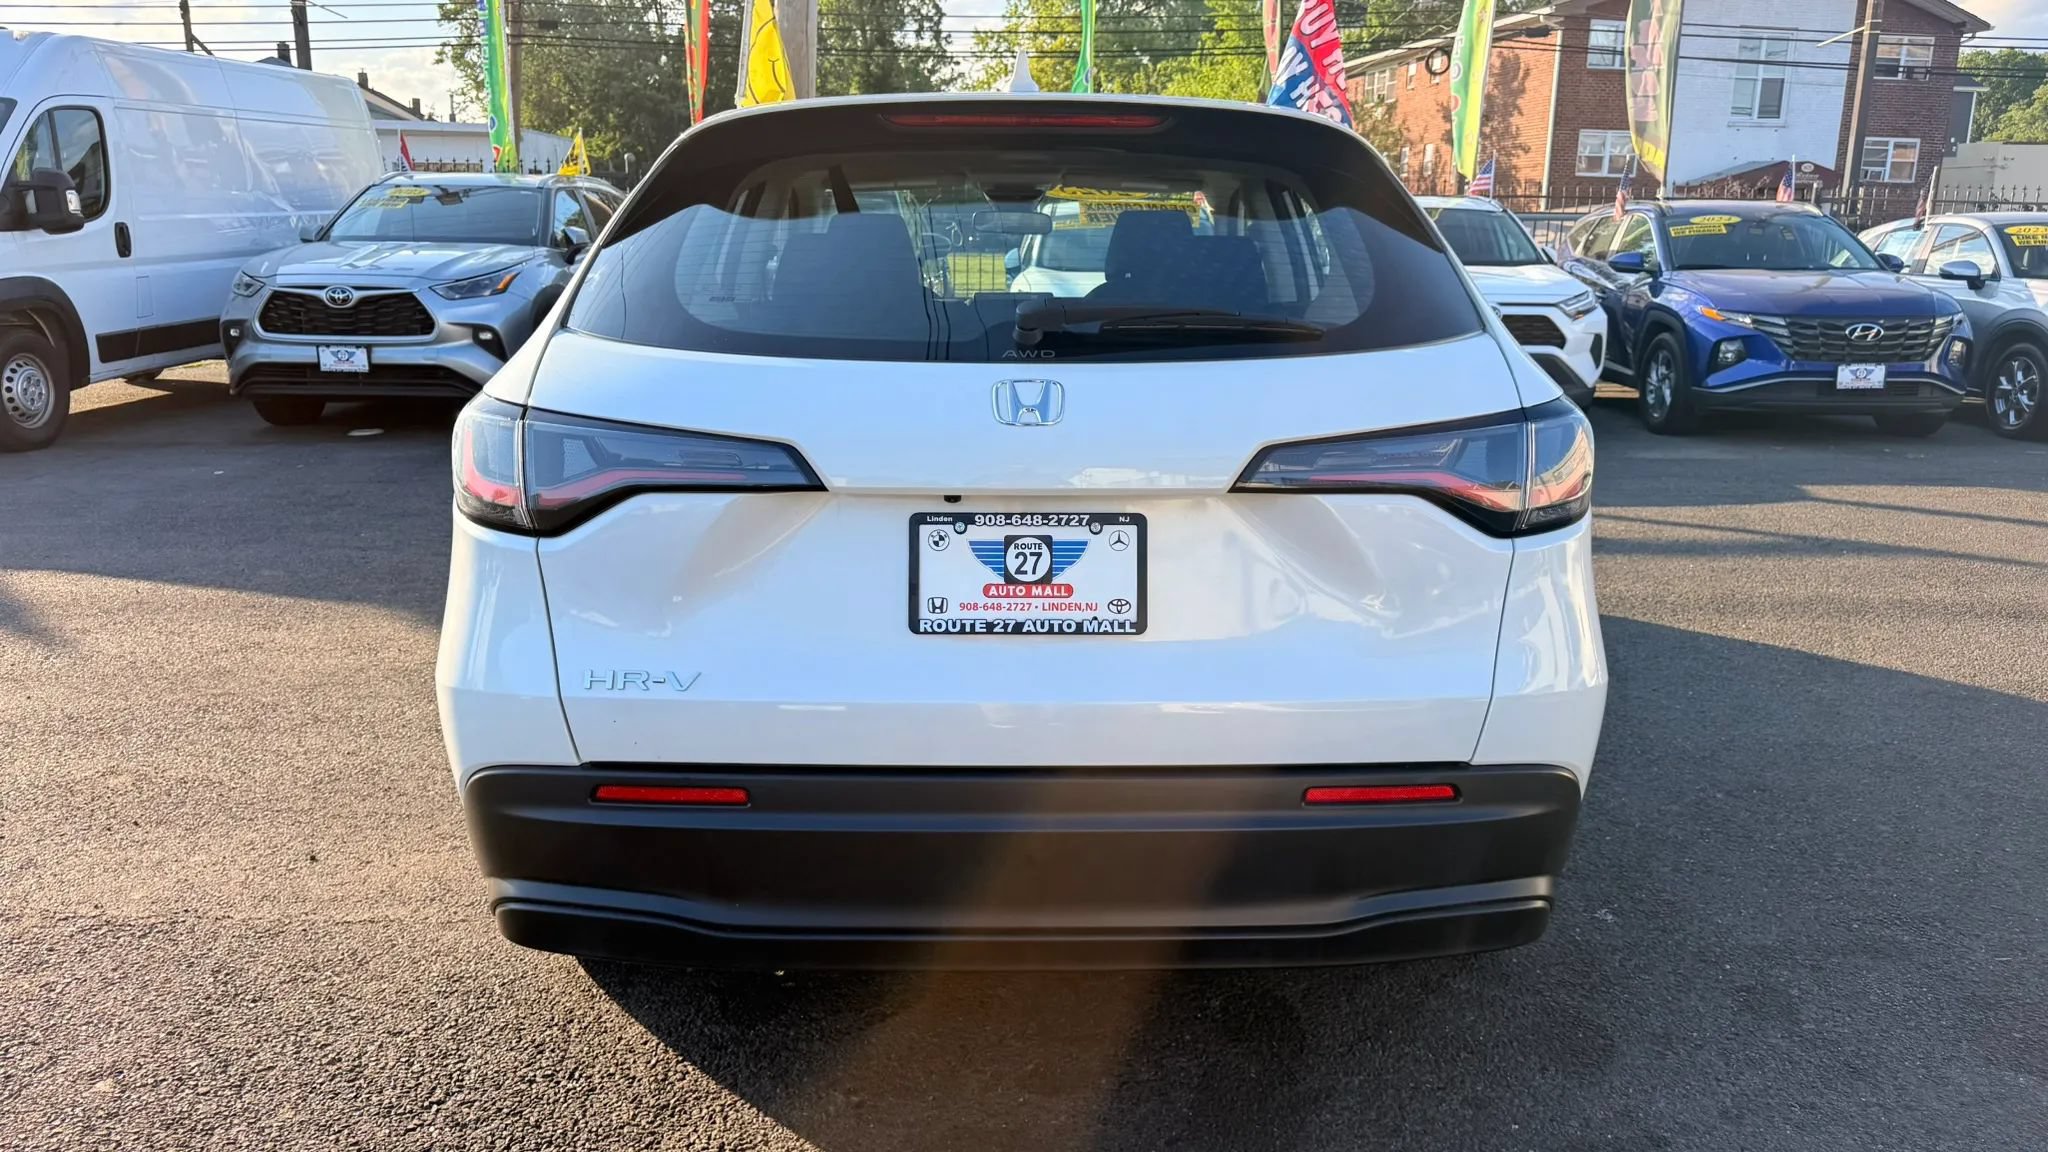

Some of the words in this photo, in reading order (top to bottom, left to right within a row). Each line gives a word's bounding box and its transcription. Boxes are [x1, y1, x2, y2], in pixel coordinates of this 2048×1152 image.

[1002, 350, 1056, 358] AWD
[974, 514, 1090, 526] 908-648-2727
[1013, 542, 1043, 550] ROUTE
[1014, 551, 1043, 575] 27
[988, 585, 1026, 596] AUTO
[1031, 585, 1068, 596] MALL
[959, 602, 1032, 612] 908-648-2727
[1042, 602, 1098, 613] LINDEN,NJ
[919, 619, 987, 633] ROUTE
[992, 619, 1016, 633] 27
[1022, 619, 1077, 633] AUTO
[1083, 619, 1137, 633] MALL
[584, 669, 702, 692] HR-V
